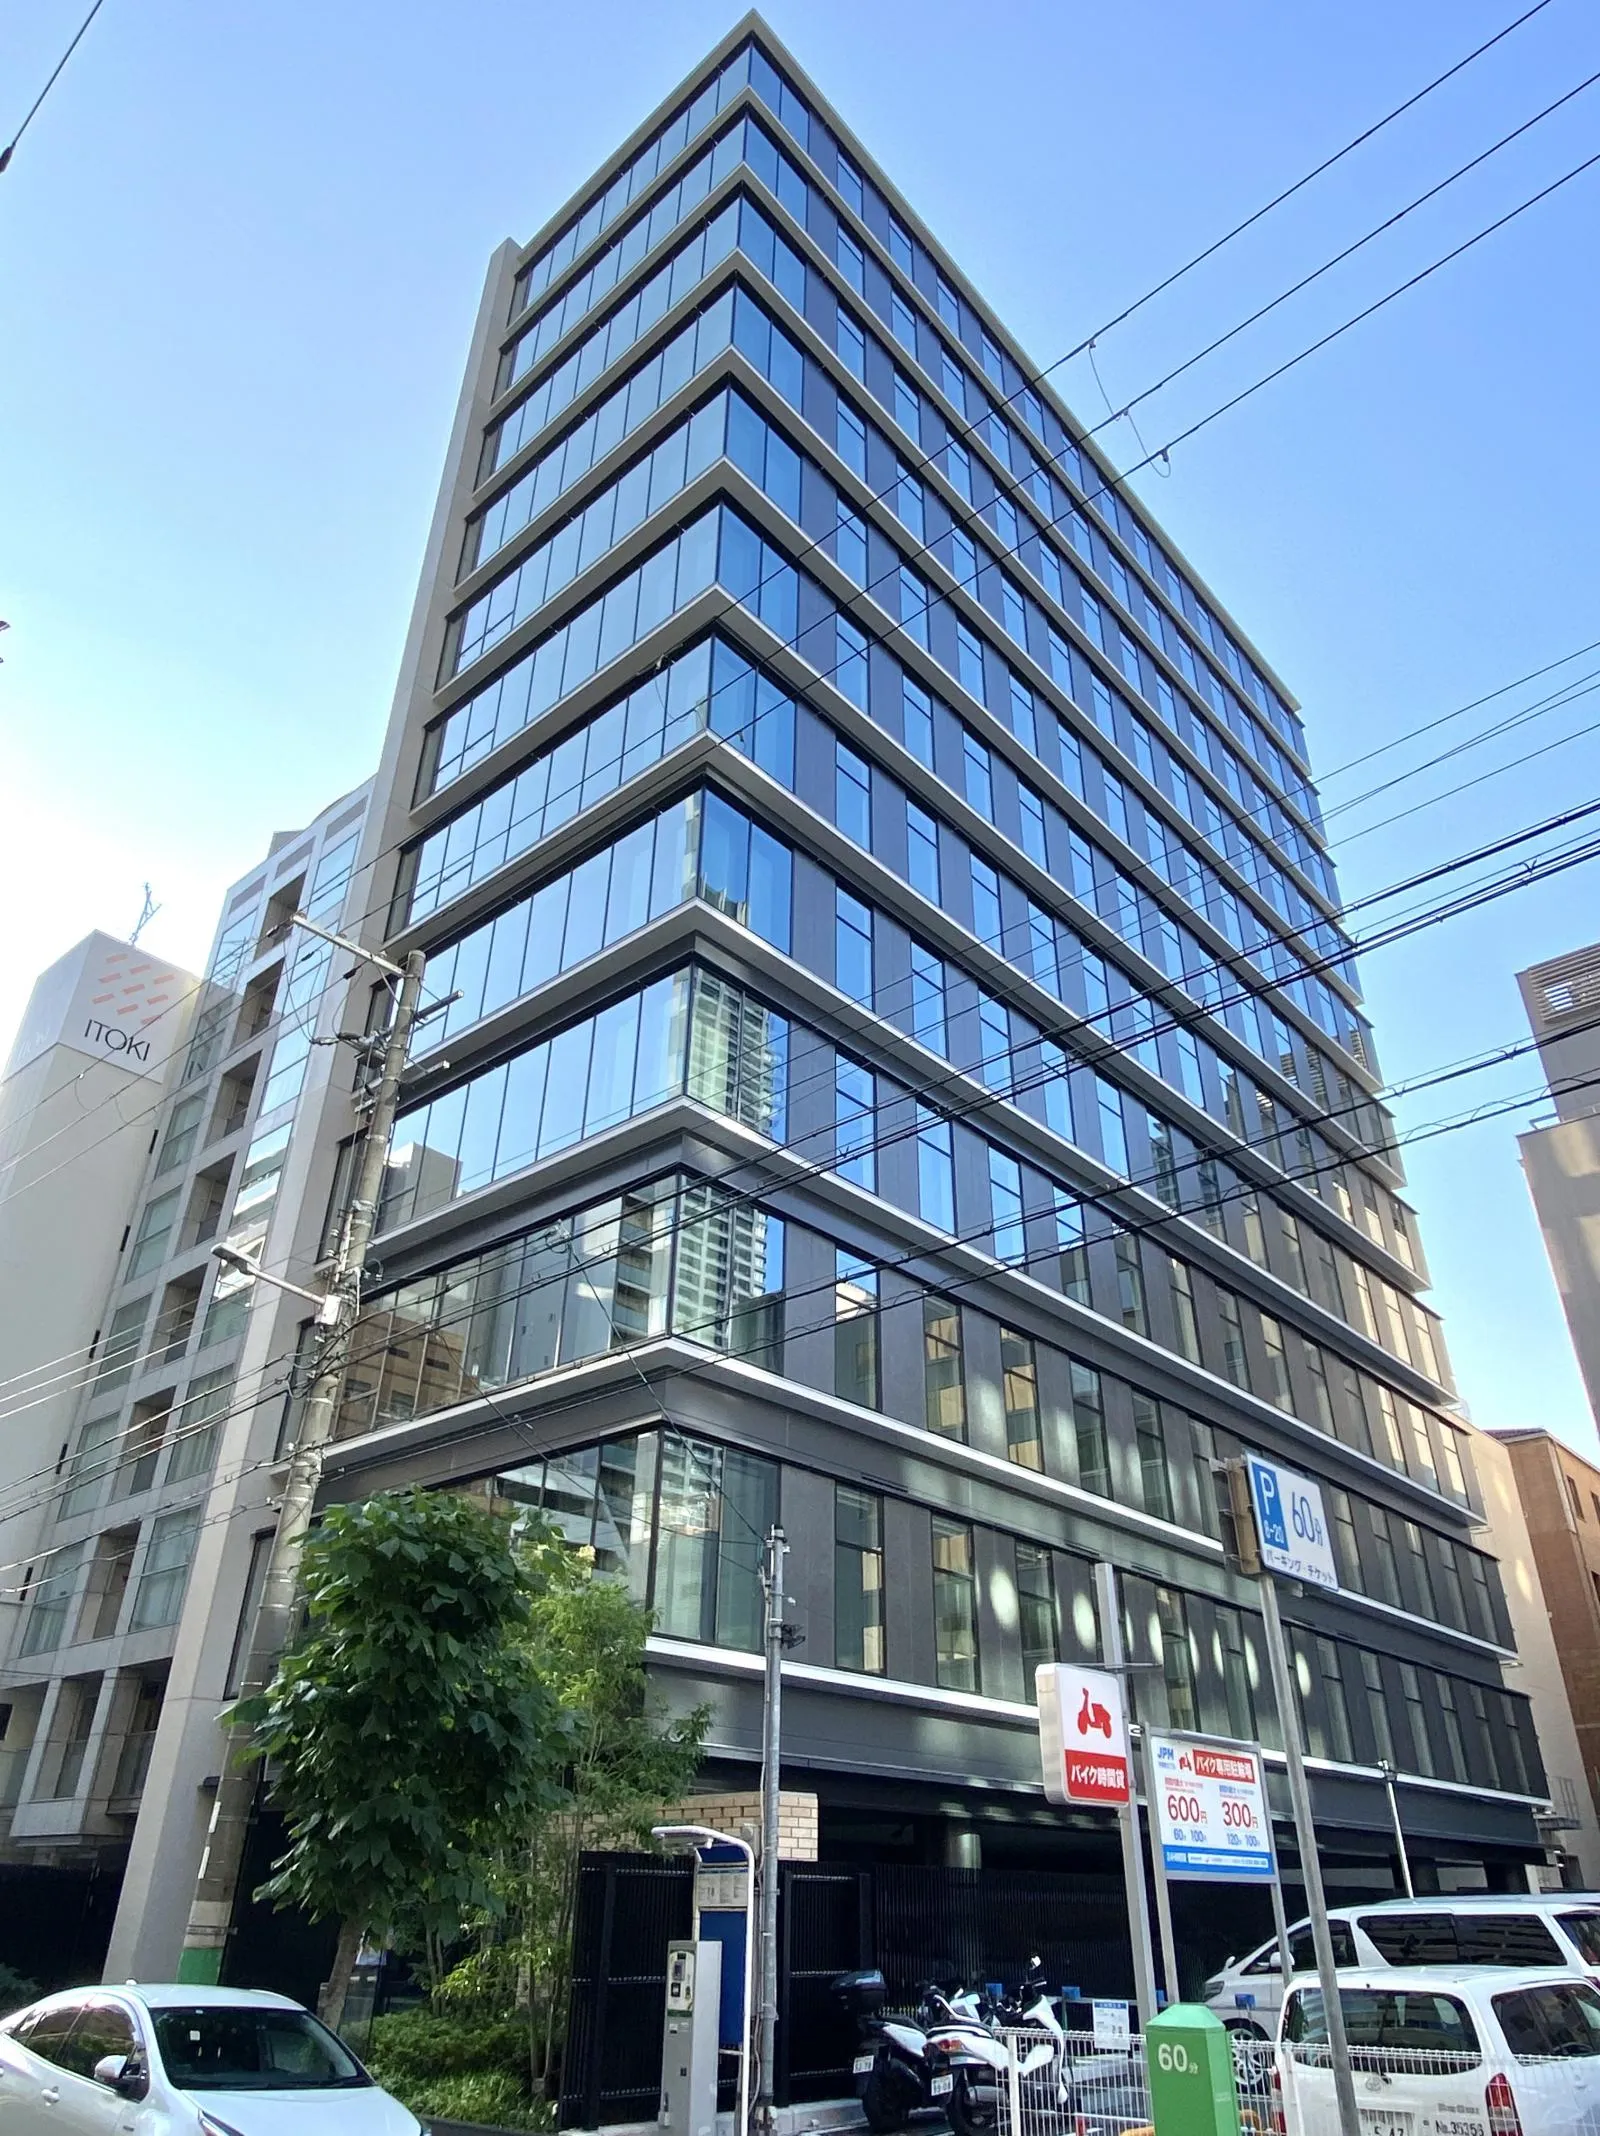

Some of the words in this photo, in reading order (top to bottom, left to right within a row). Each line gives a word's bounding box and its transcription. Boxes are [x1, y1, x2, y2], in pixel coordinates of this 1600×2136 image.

[84, 1018, 151, 1061] ITOKI
[1259, 1471, 1275, 1515] P
[1071, 1764, 1126, 1790] バイク時間貸
[1167, 1794, 1208, 1825] 600円
[1221, 1801, 1259, 1829] 300円
